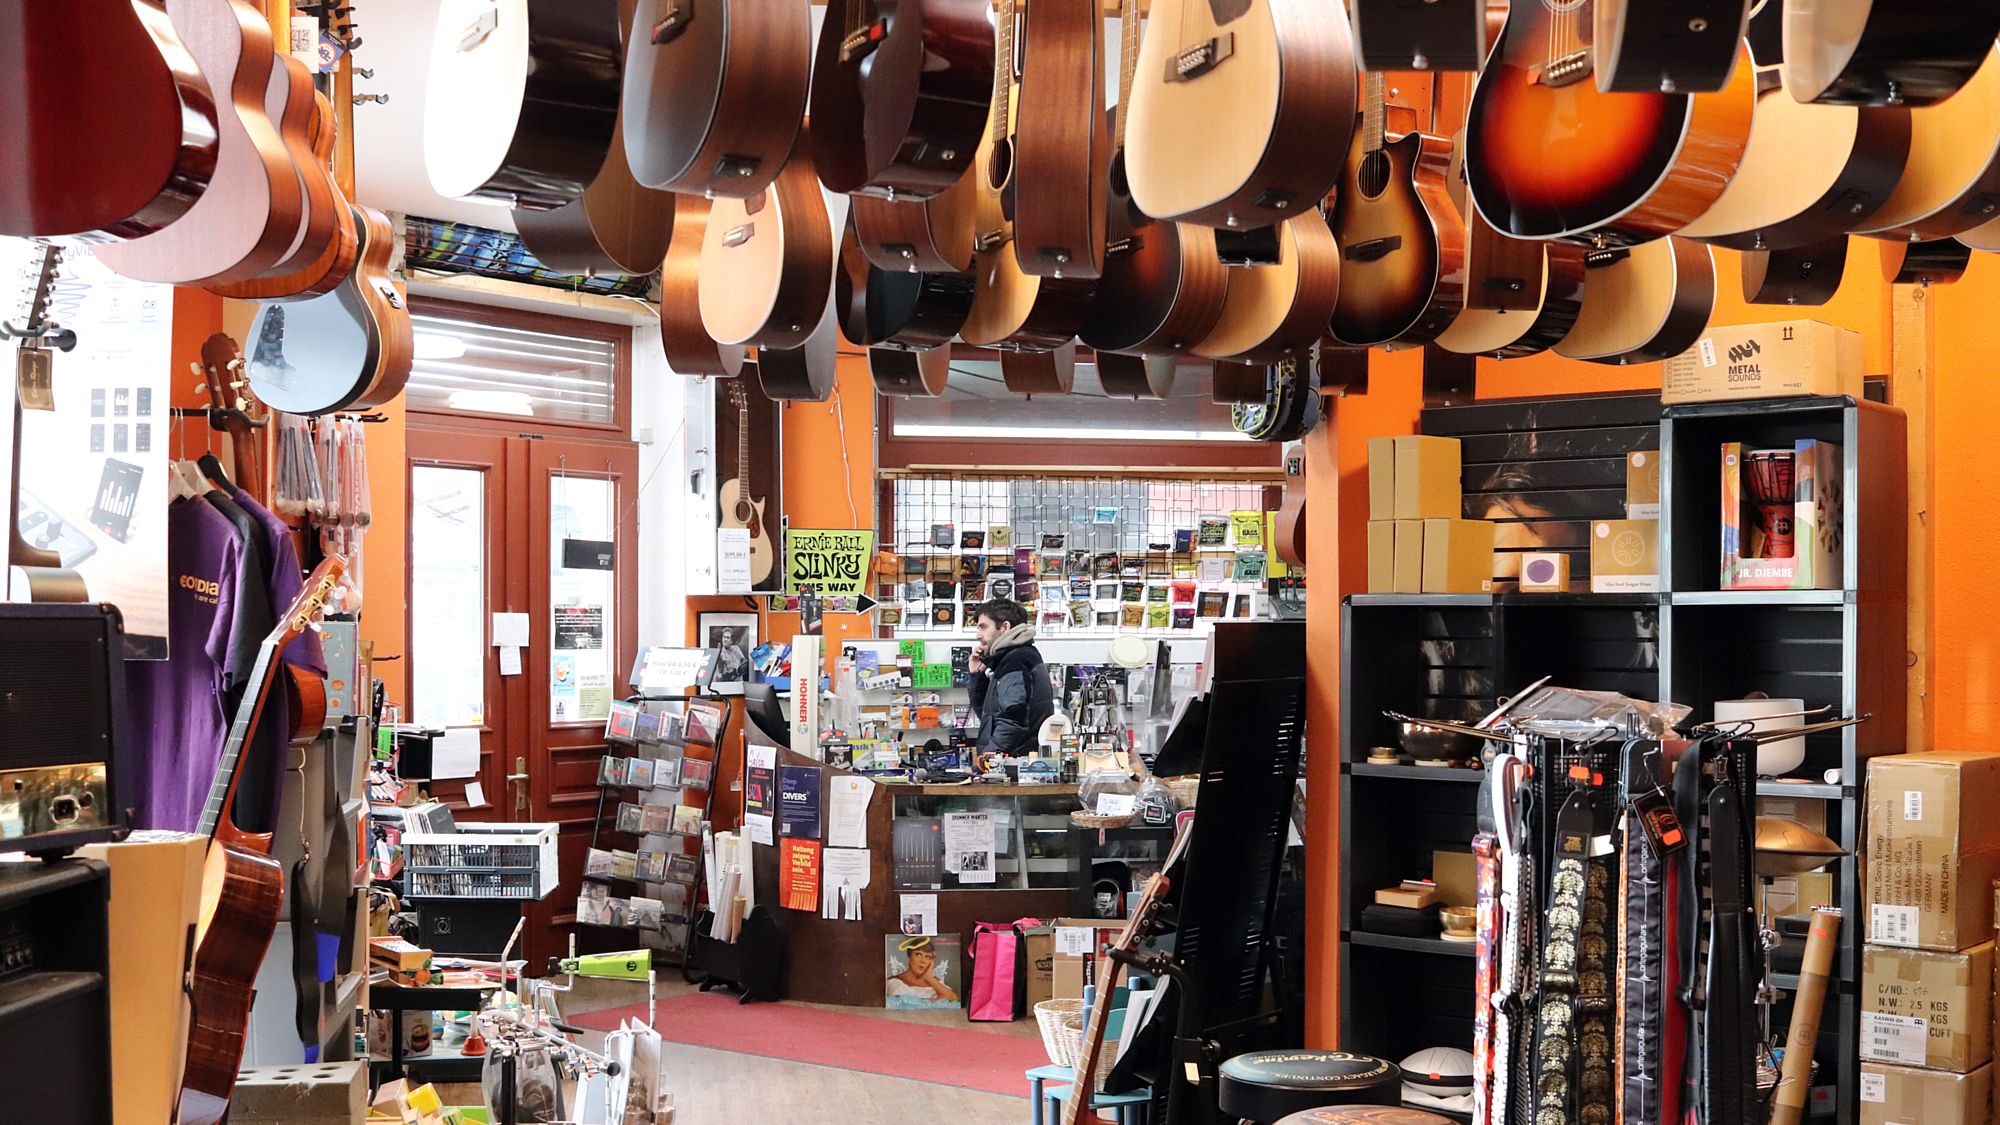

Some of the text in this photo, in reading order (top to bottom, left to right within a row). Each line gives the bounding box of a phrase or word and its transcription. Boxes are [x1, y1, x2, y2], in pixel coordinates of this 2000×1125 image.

[1728, 364, 1761, 375] METAL
[1728, 373, 1761, 383] SOUNDS
[792, 532, 864, 551] ERNIE BALL
[793, 552, 862, 580] SLINKY
[1738, 568, 1794, 578] JR. DJEMBE
[793, 583, 856, 592] TIS WAY
[799, 678, 808, 723] HOHNER
[783, 778, 798, 786] Deep
[783, 792, 807, 801] DIVERS
[1885, 799, 1893, 859] Musikinstrumente
[792, 845, 815, 855] Haltung
[1875, 833, 1884, 860] Energy
[792, 853, 811, 862] zeigen
[1895, 851, 1902, 864] KG
[1915, 840, 1923, 886] Gutenstetten
[792, 859, 812, 868] Vorbild
[1895, 880, 1902, 888] &
[1941, 854, 1949, 914] MADE IN CHINA
[1639, 924, 1648, 972] ortegaguitars
[1878, 984, 1908, 995] C/NO.:
[1878, 997, 1948, 1012] N.W.: 2.5 KGS
[1930, 1014, 1948, 1025] KGS
[1929, 1027, 1951, 1038] CUFT
[1636, 1023, 1645, 1070] ortegaguitars
[1252, 1051, 1374, 1065] Takamine
[1343, 1069, 1379, 1080] LEGACY
